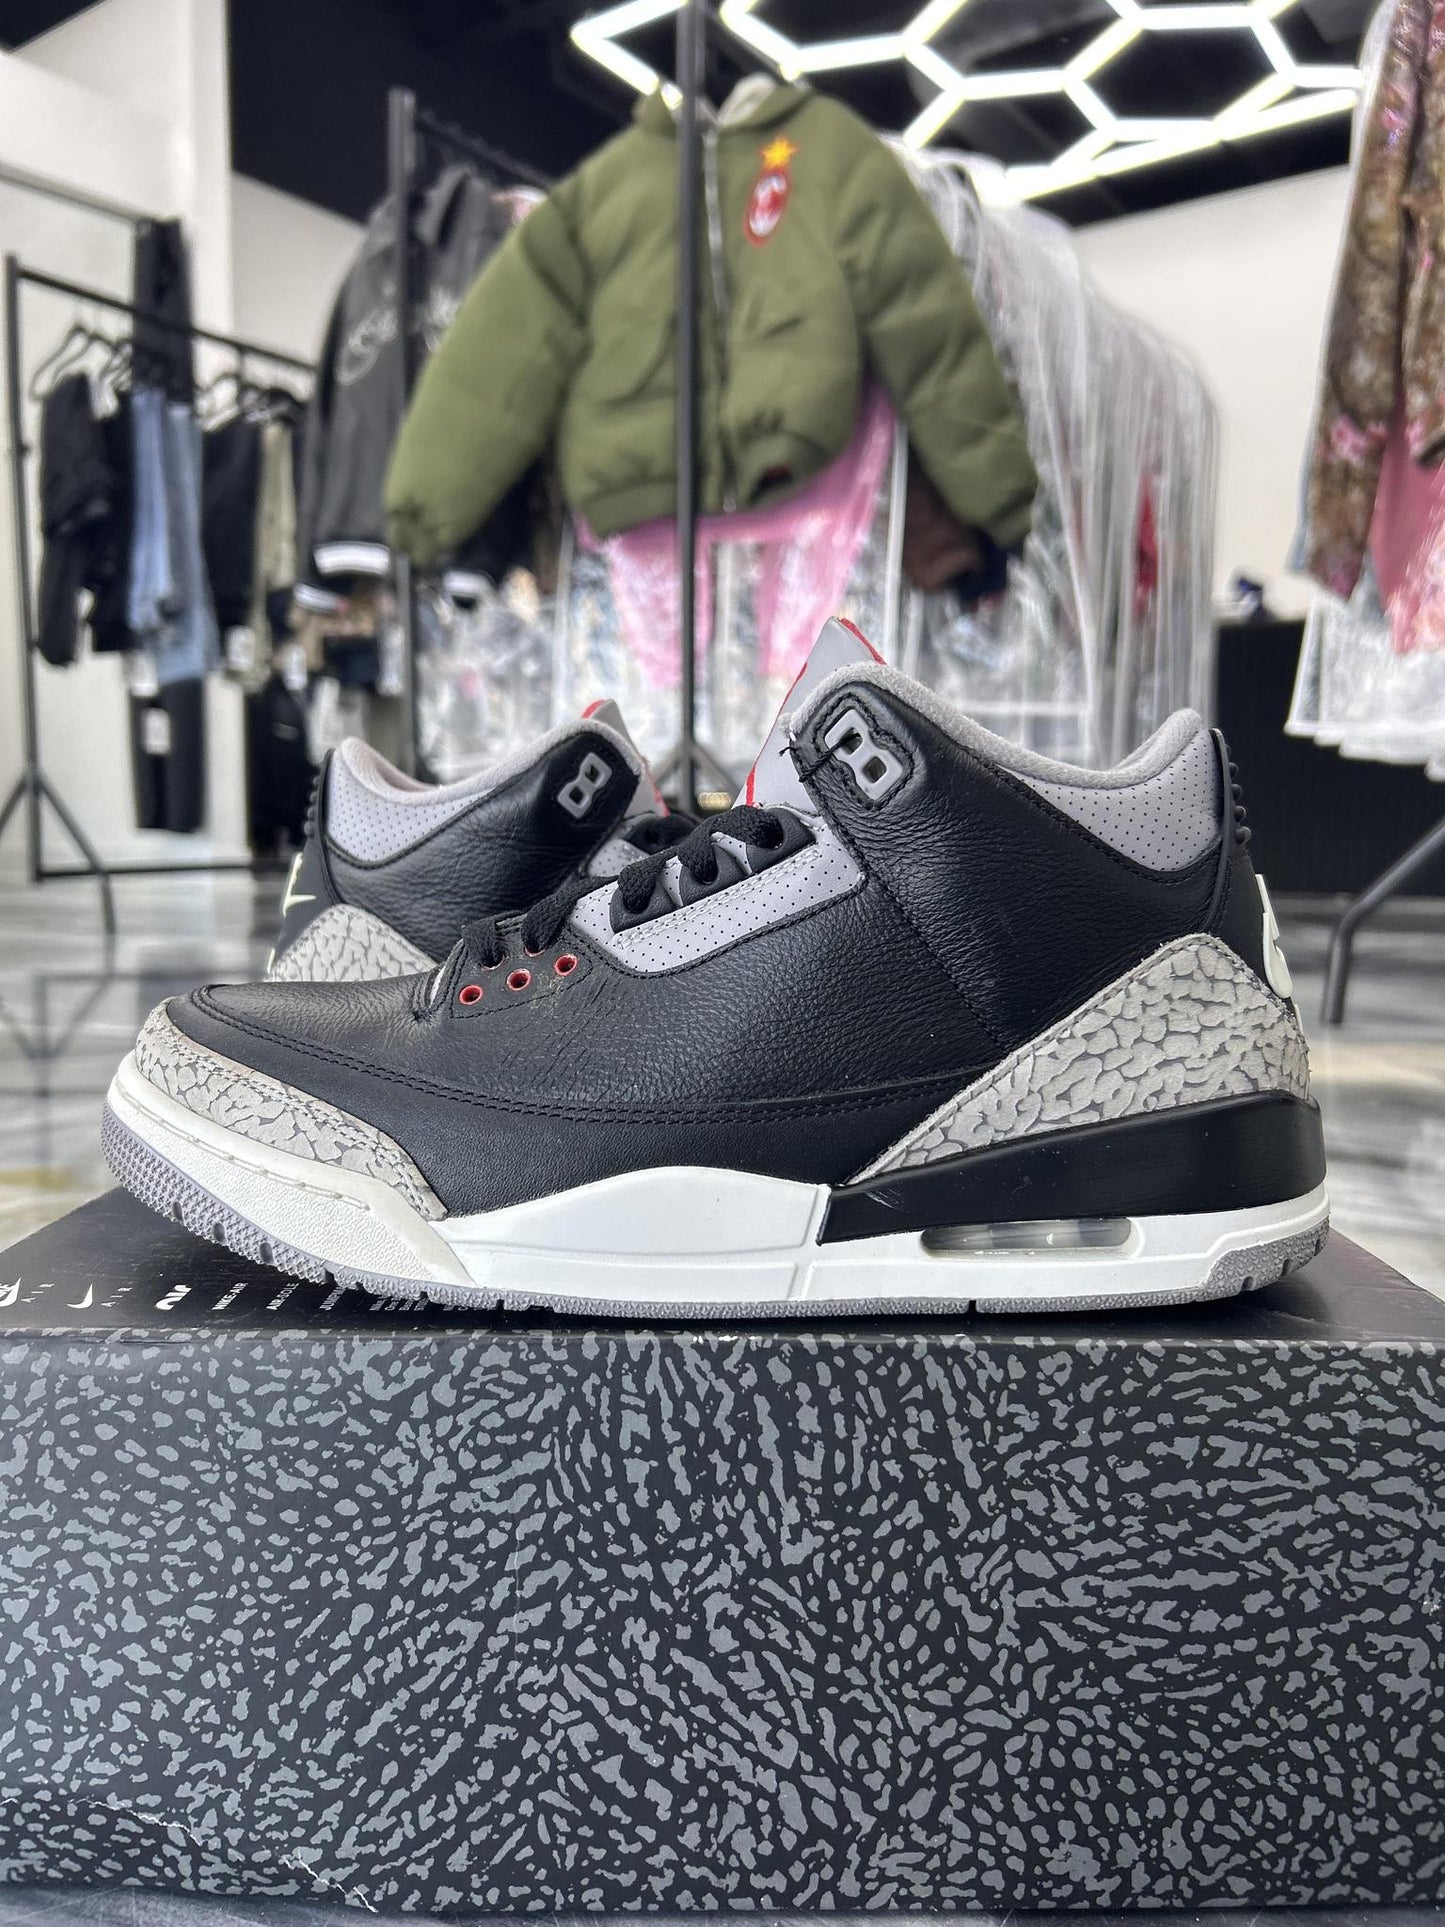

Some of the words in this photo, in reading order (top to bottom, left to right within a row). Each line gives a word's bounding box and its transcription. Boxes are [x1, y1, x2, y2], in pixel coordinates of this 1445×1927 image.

[21, 1284, 54, 1302] AIR
[101, 1287, 132, 1307] AIR
[212, 1282, 248, 1310] NIKE-AIR
[266, 1282, 299, 1310] AIR-SOLE
